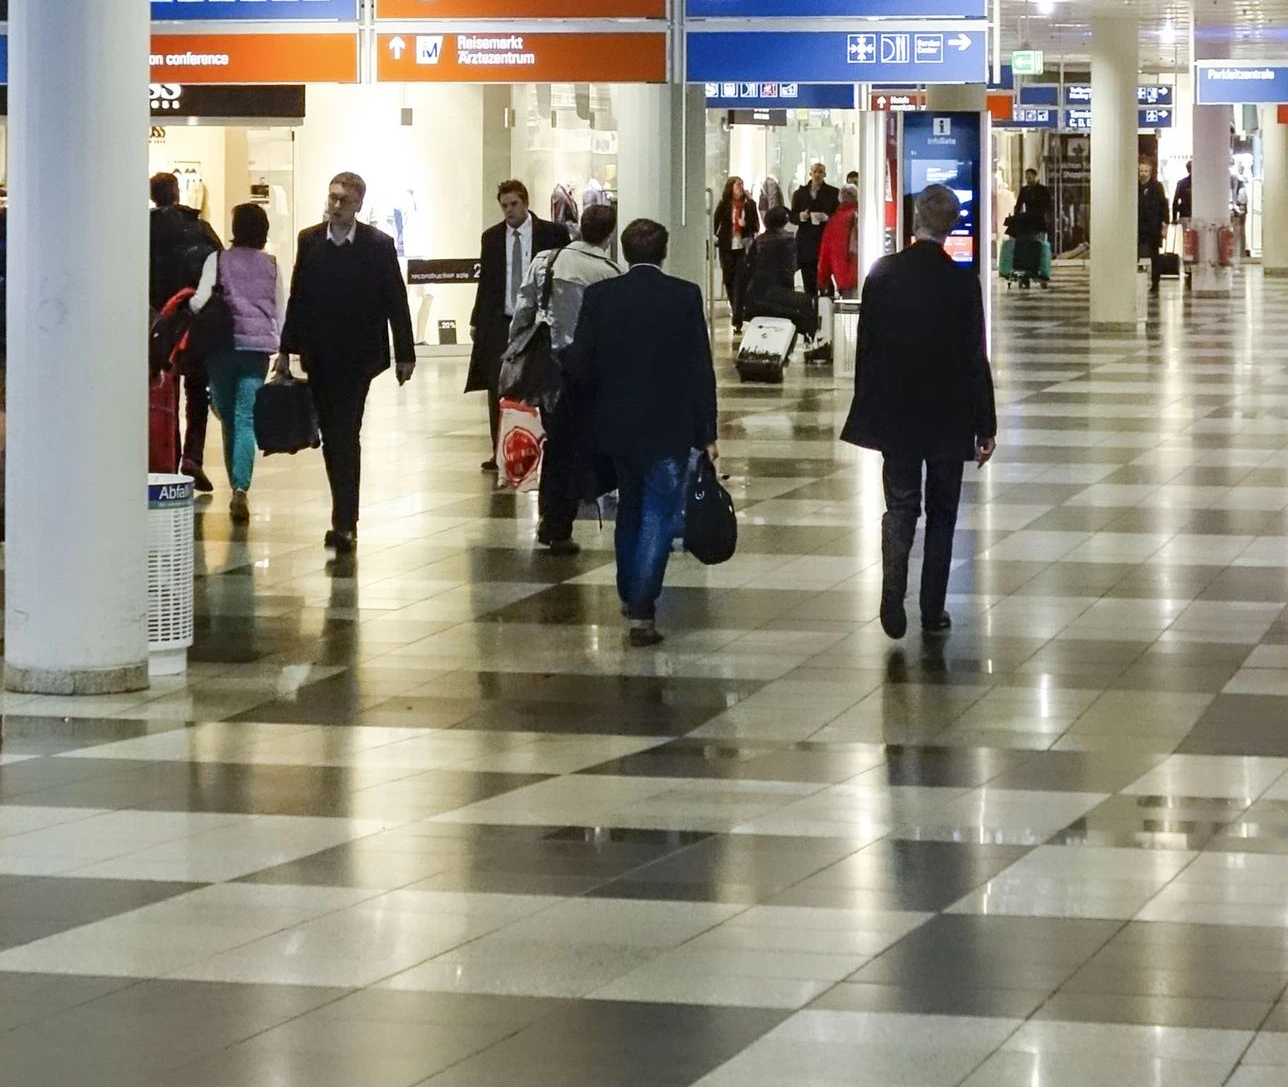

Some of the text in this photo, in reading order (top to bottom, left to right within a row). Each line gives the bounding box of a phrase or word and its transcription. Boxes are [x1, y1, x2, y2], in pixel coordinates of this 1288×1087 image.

[457, 35, 523, 50] Reisemarkt
[166, 52, 229, 66] conference
[457, 51, 535, 64] Ärztezentrum
